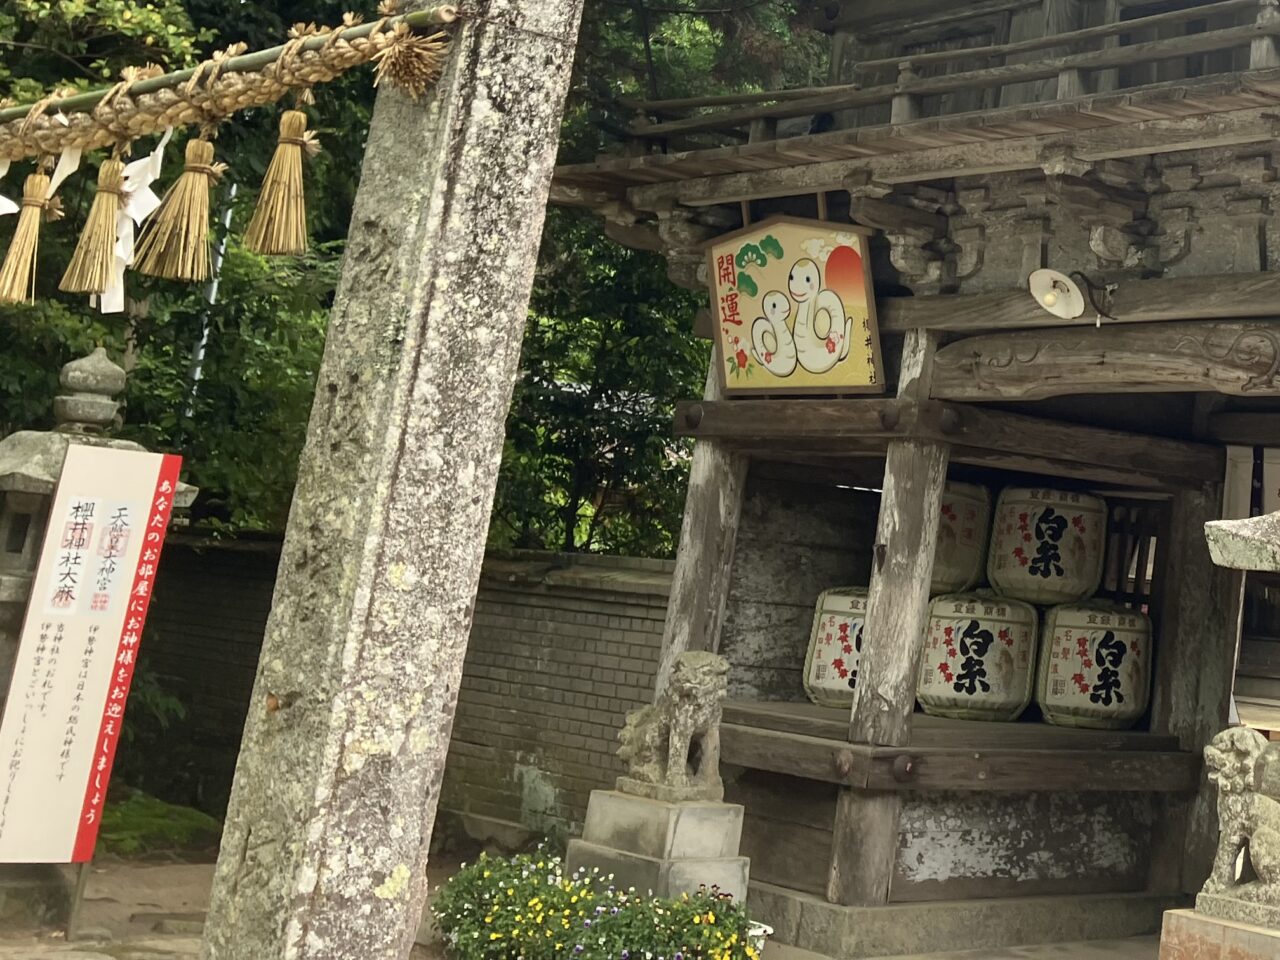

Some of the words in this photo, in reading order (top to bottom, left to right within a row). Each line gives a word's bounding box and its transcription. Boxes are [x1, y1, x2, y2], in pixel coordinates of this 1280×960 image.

[717, 253, 743, 326] 開運
[52, 501, 96, 602] 櫻井神社大麻
[1028, 507, 1068, 578] 白糸
[85, 479, 172, 825] あなたのお部屋にお神様をお迎えしましょう
[953, 619, 995, 695] 白糸
[1089, 630, 1127, 707] 白糸
